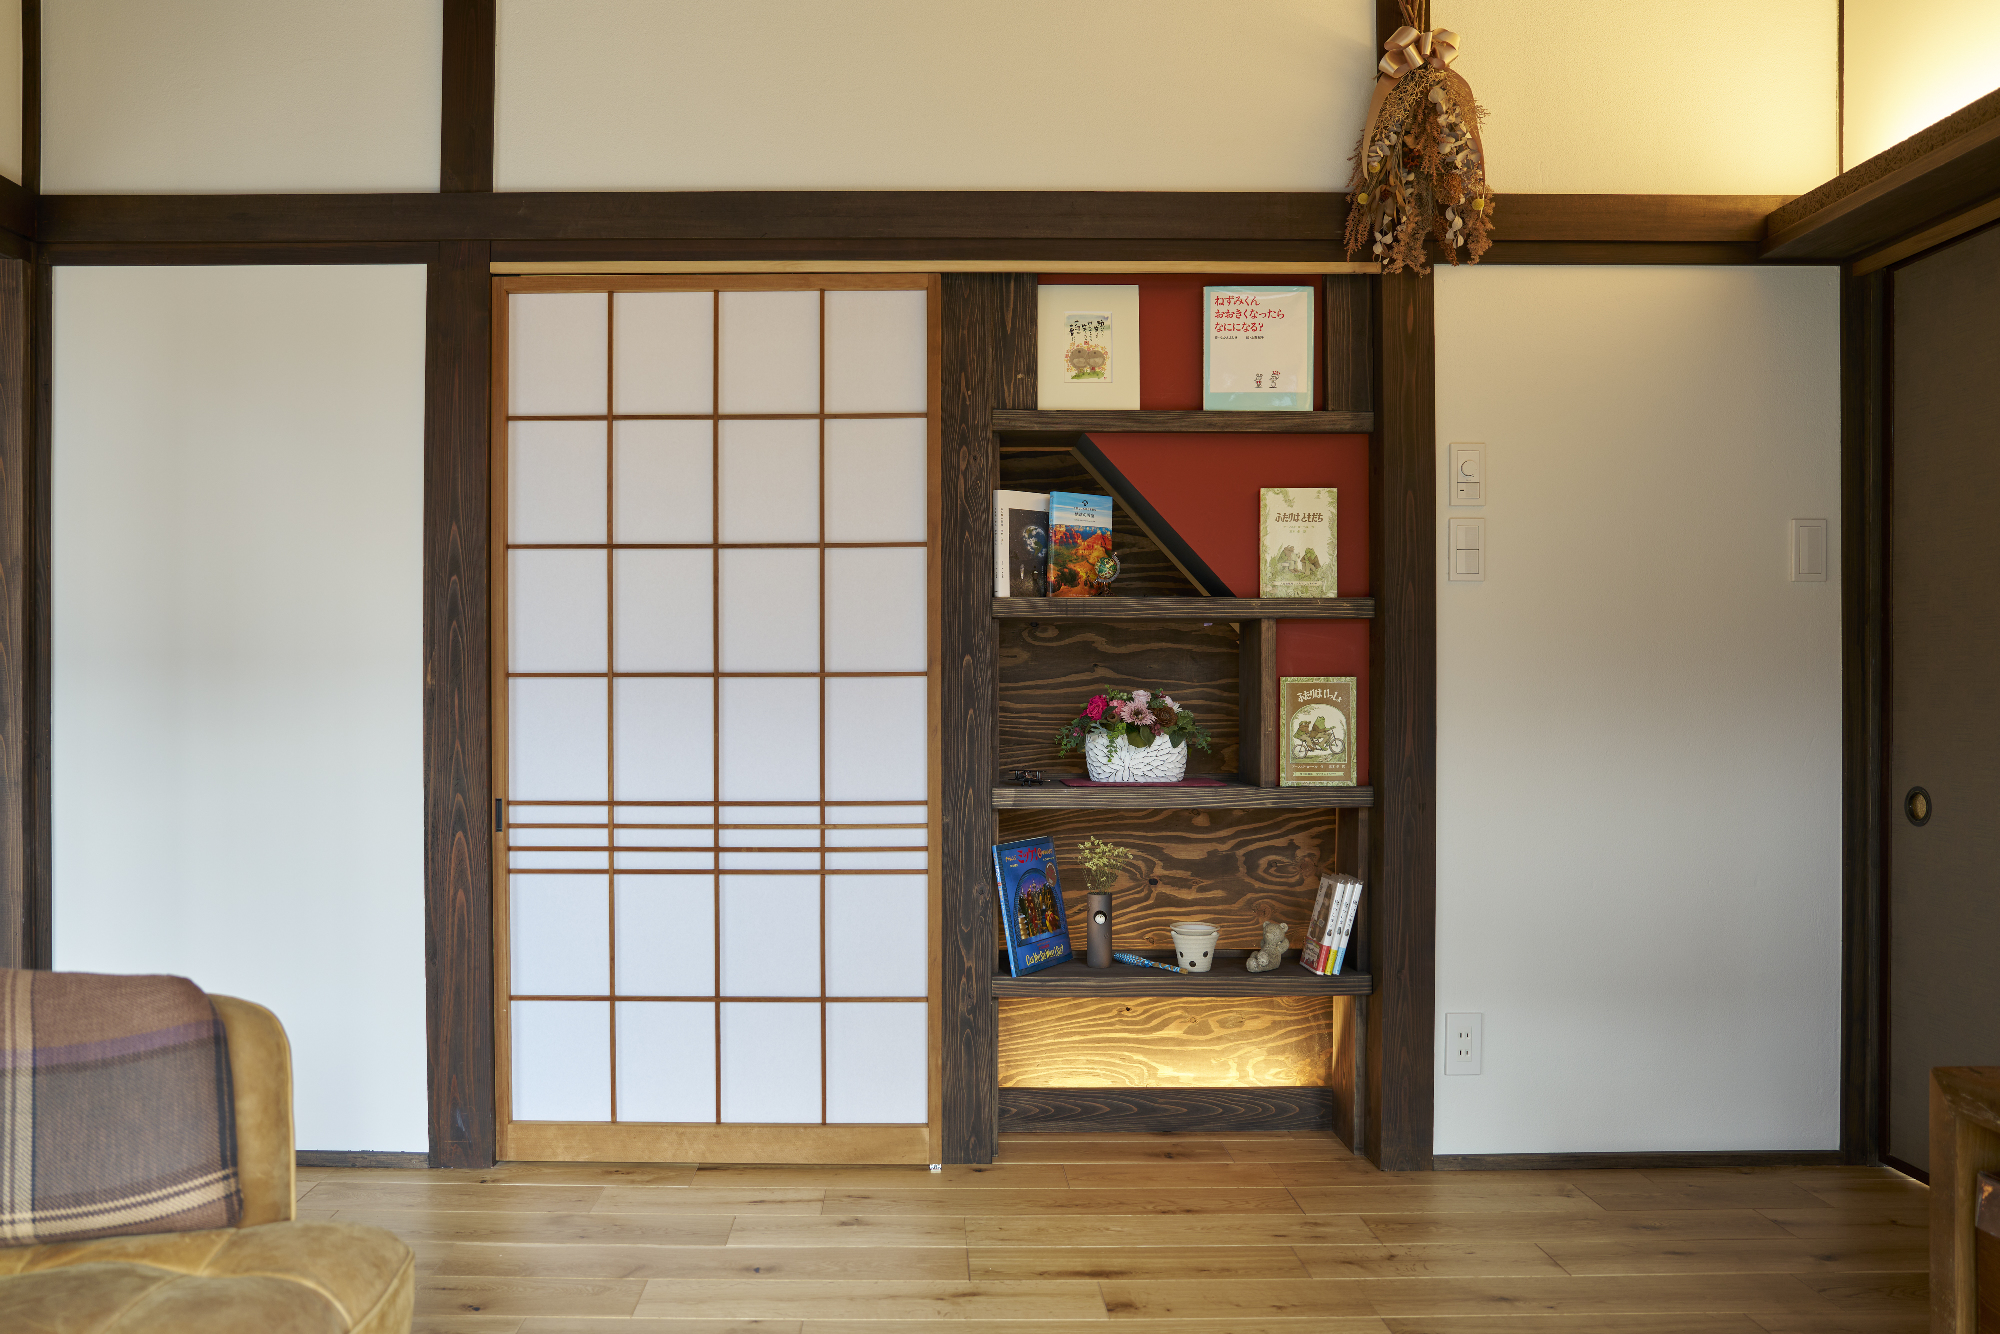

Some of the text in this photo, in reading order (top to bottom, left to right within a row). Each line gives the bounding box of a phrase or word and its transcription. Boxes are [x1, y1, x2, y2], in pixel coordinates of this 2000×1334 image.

[1214, 295, 1261, 306] ねずみくん
[1214, 308, 1285, 320] おおきくなったら
[1214, 321, 1264, 333] なにになる?
[1275, 512, 1324, 523] ふたりは ともだち
[1296, 688, 1322, 703] ふたりは
